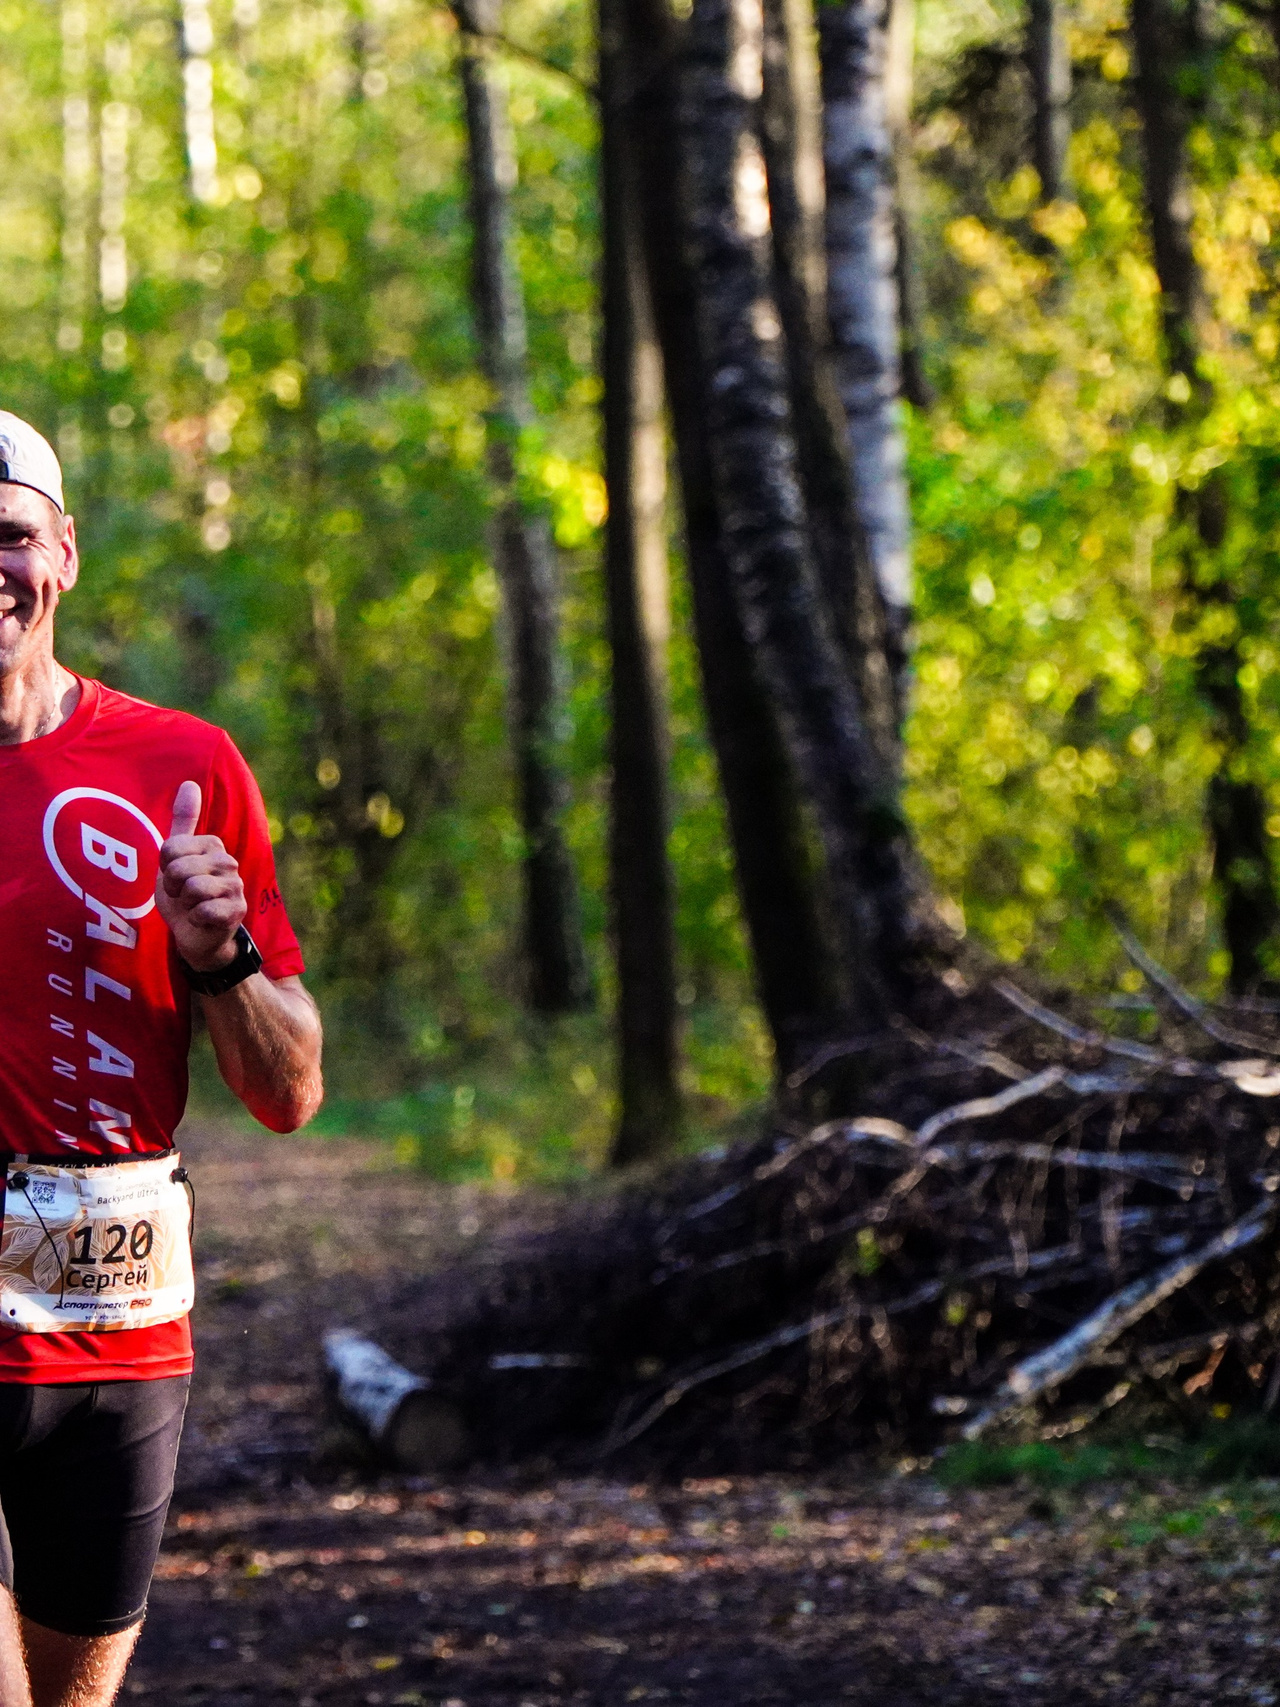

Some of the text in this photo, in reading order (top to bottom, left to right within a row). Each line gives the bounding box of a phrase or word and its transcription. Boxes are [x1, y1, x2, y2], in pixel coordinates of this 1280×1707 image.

[97, 1192, 134, 1205] Backyard
[70, 1220, 153, 1265] 120
[66, 1265, 148, 1293] Сергей
[129, 1298, 153, 1309] PRO
